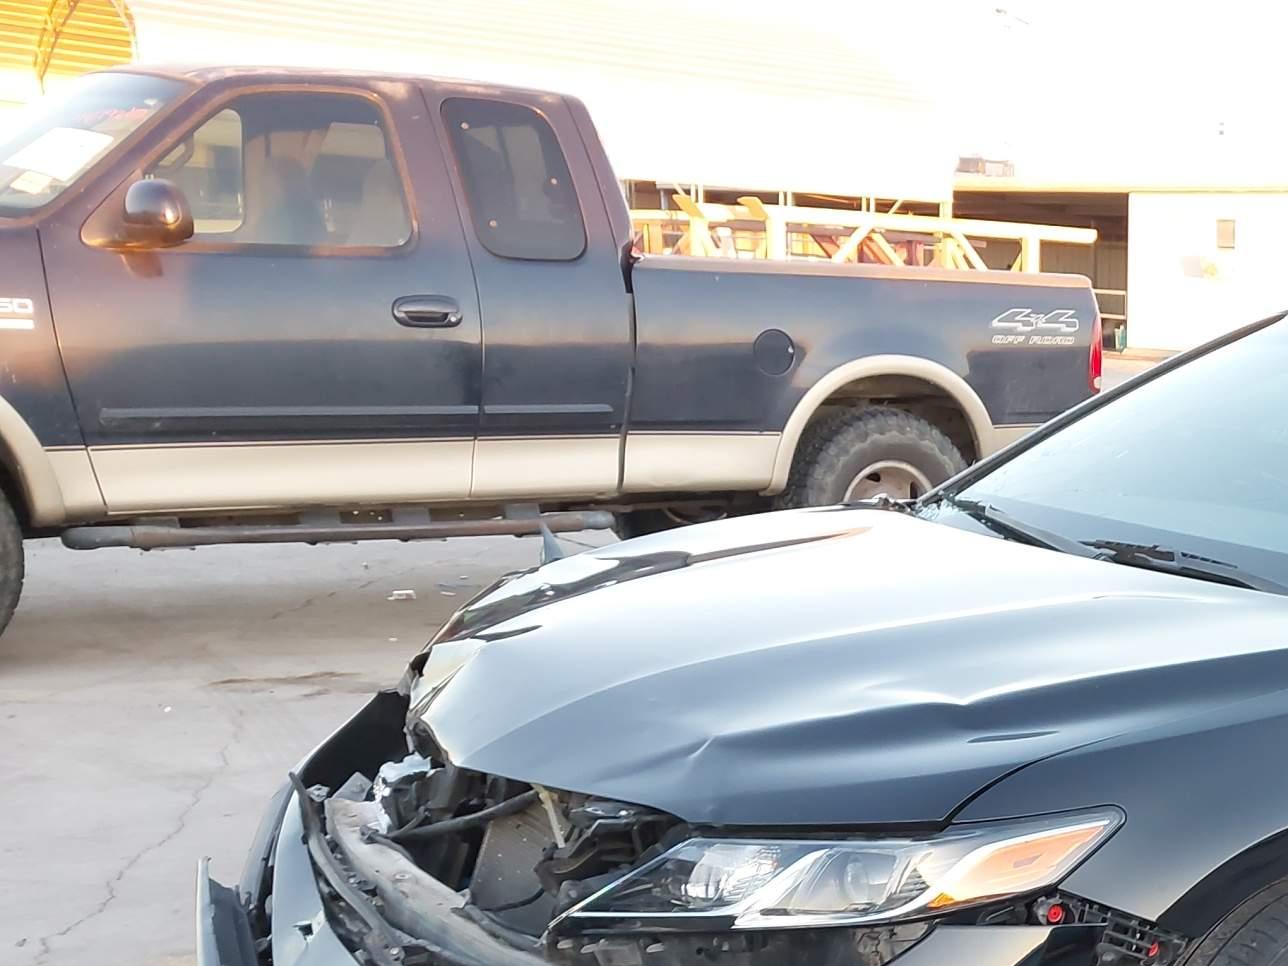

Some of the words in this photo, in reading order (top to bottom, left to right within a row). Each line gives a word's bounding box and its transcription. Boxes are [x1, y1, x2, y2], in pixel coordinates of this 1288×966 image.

[991, 308, 1079, 332] 4x4
[991, 335, 1026, 344] OFF
[1029, 335, 1075, 345] ROAD
